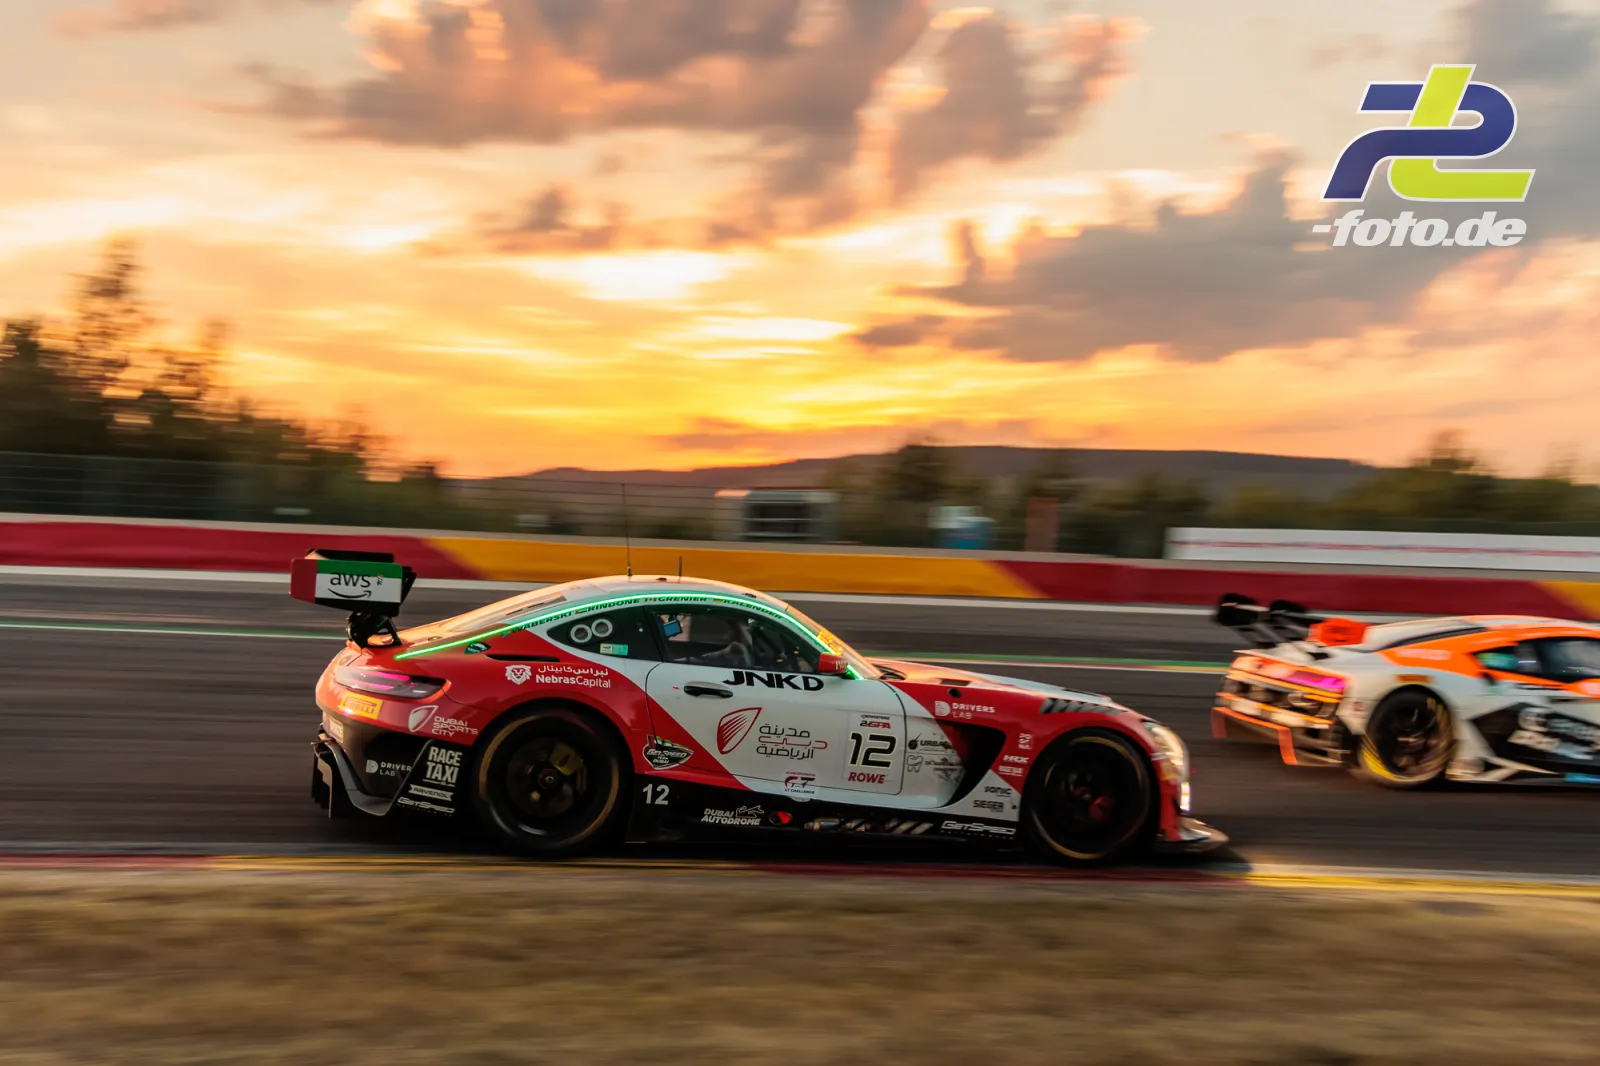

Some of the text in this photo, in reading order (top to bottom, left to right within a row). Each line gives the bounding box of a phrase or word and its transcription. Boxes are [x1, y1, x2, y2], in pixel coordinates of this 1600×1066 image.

[330, 572, 371, 588] aws
[723, 670, 824, 691] JNKD
[952, 702, 995, 714] DRIVERS
[433, 716, 468, 727] DUBAI
[953, 711, 972, 719] LAB
[431, 728, 456, 737] CITY
[433, 722, 479, 735] SPORTS
[759, 723, 811, 739] مدينة
[428, 746, 463, 766] RACE
[756, 744, 814, 760] الرياضية
[848, 732, 897, 768] 12
[379, 769, 396, 777] LAB
[426, 762, 461, 783] TAXI
[848, 771, 885, 784] ROWE
[642, 784, 670, 806] 12
[704, 808, 735, 818] DUBAI
[701, 815, 761, 826] AUTODROME
